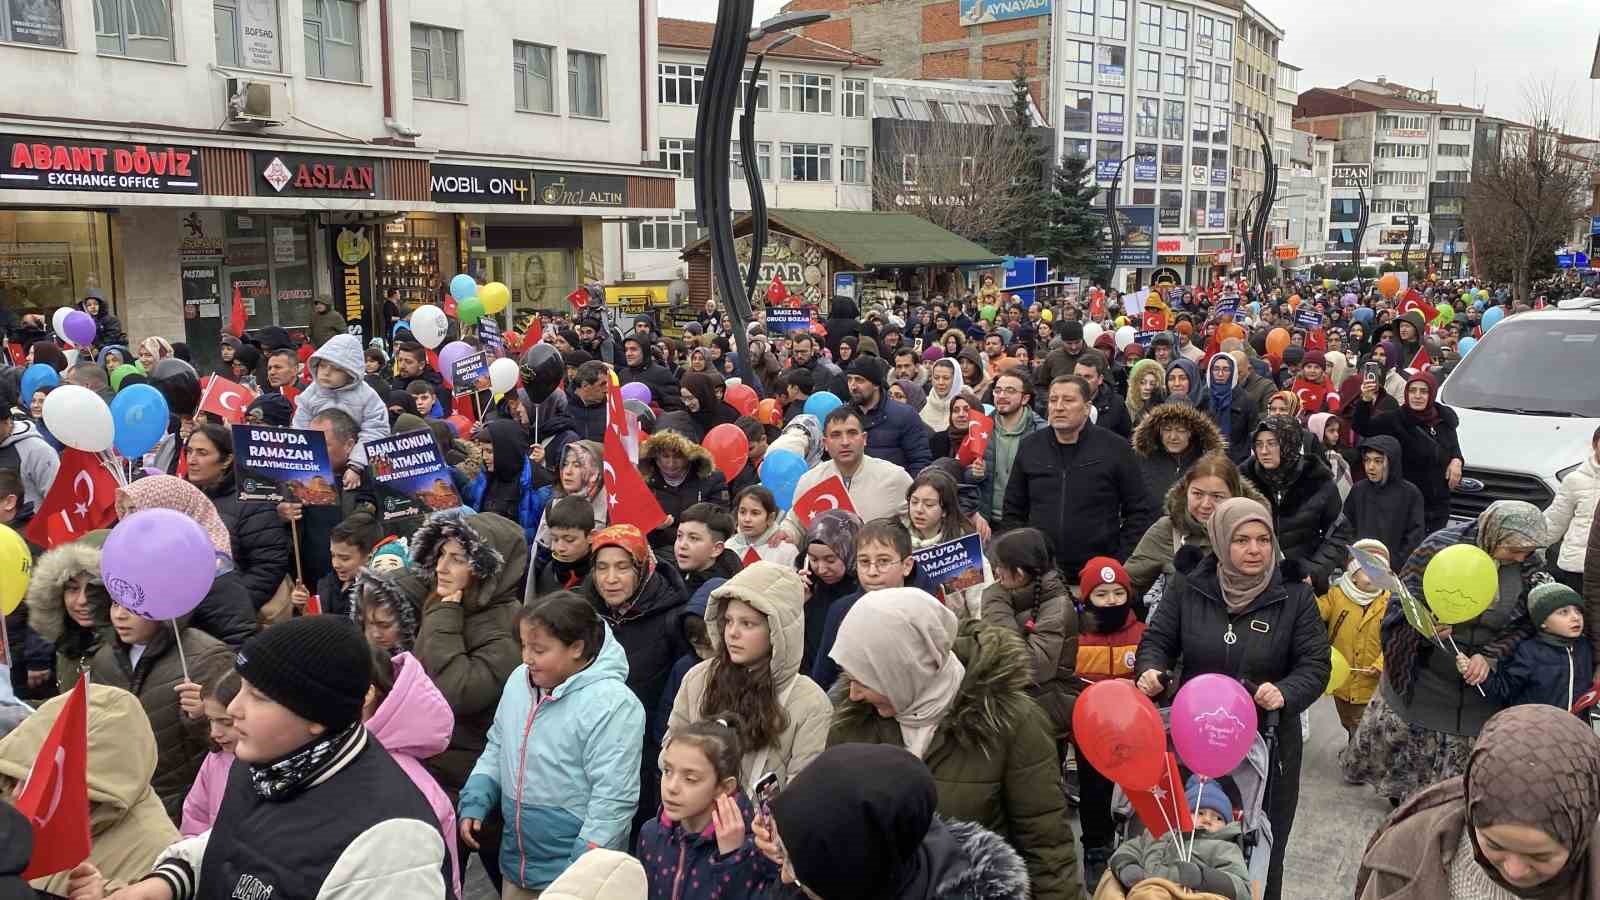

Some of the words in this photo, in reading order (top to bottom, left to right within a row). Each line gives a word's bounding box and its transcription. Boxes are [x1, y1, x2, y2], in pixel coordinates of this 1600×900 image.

[11, 142, 108, 172] ABANT
[114, 144, 192, 177] DÖVİZ
[48, 172, 117, 187] EXCHANGE
[293, 161, 373, 191] ASLAN
[1332, 168, 1368, 178] ULTAN
[250, 430, 308, 445] BOLU'DA
[366, 442, 396, 457] BANA
[395, 433, 433, 451] KONUM
[249, 446, 313, 461] RAMAZAN
